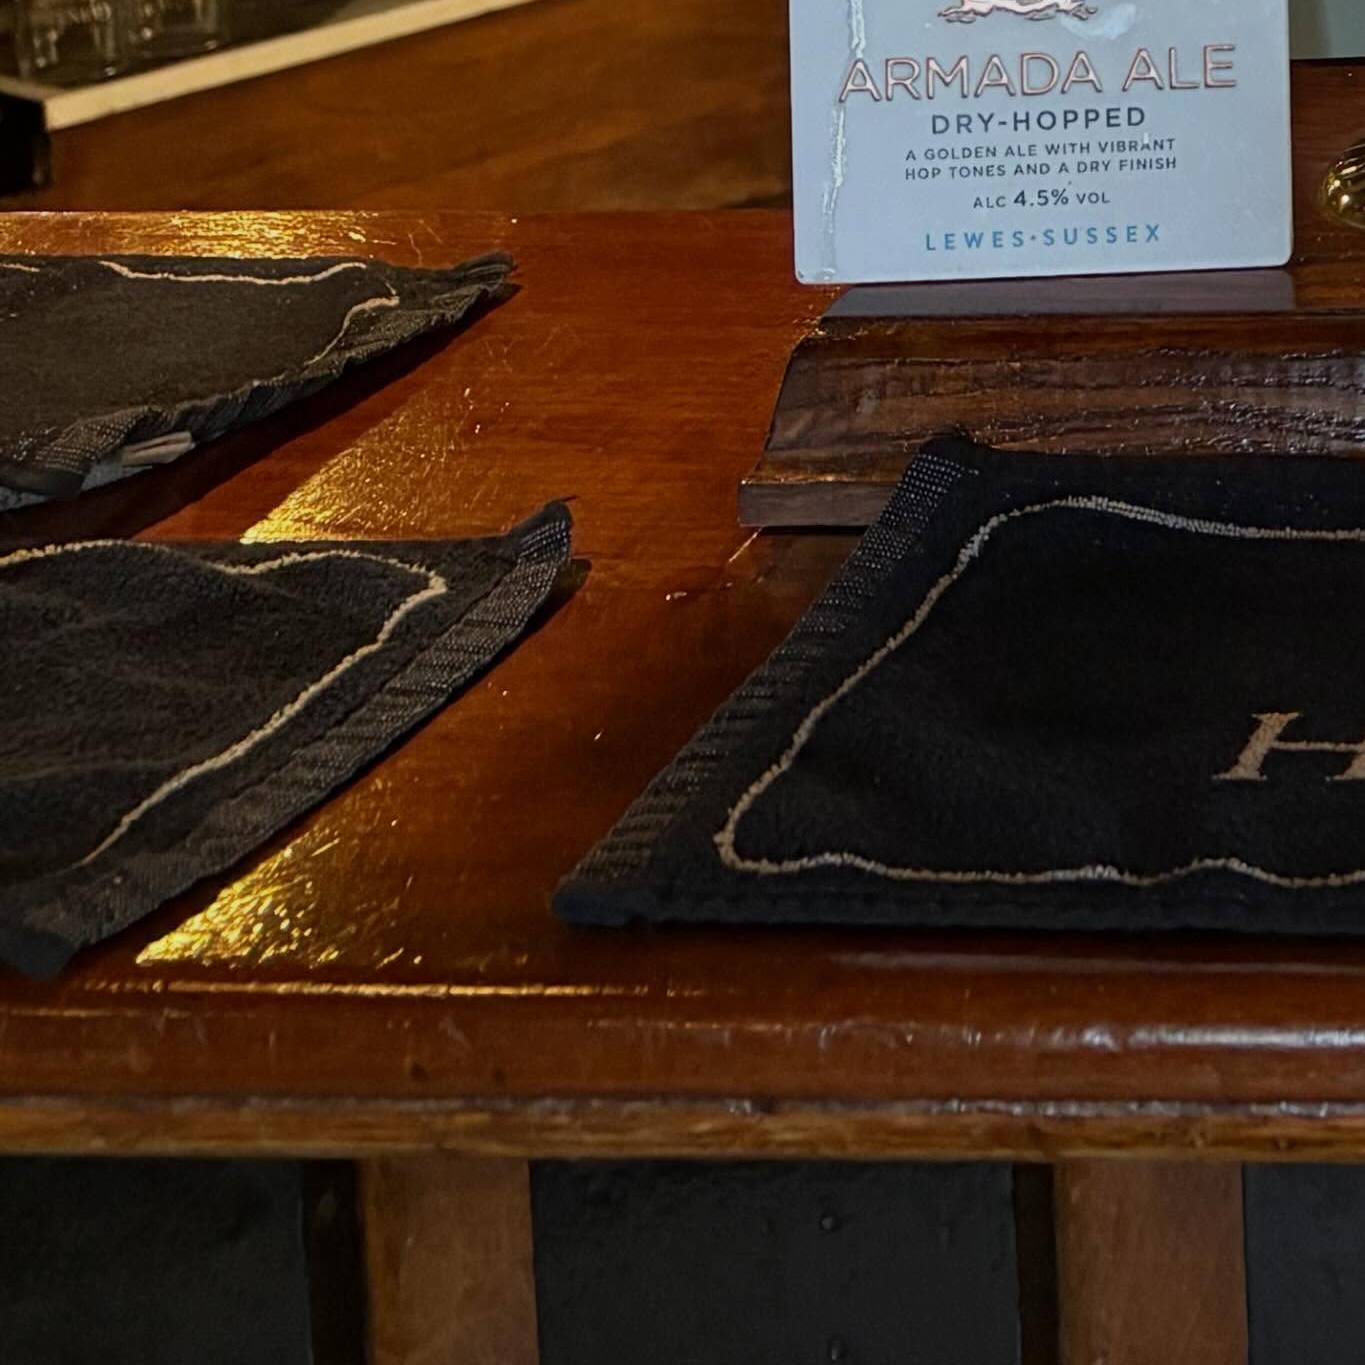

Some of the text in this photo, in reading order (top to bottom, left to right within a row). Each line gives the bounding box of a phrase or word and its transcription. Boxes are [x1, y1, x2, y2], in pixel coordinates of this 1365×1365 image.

[838, 42, 1238, 104] ARMADA ALE
[931, 106, 1147, 135] DRY-HOPPED
[905, 137, 1177, 162] A GOLDEN ALE WITH VIBRANT
[904, 156, 1178, 181] HOP TONES AND A DRY FINISH
[973, 187, 1111, 209] ALC 4.5% VOL
